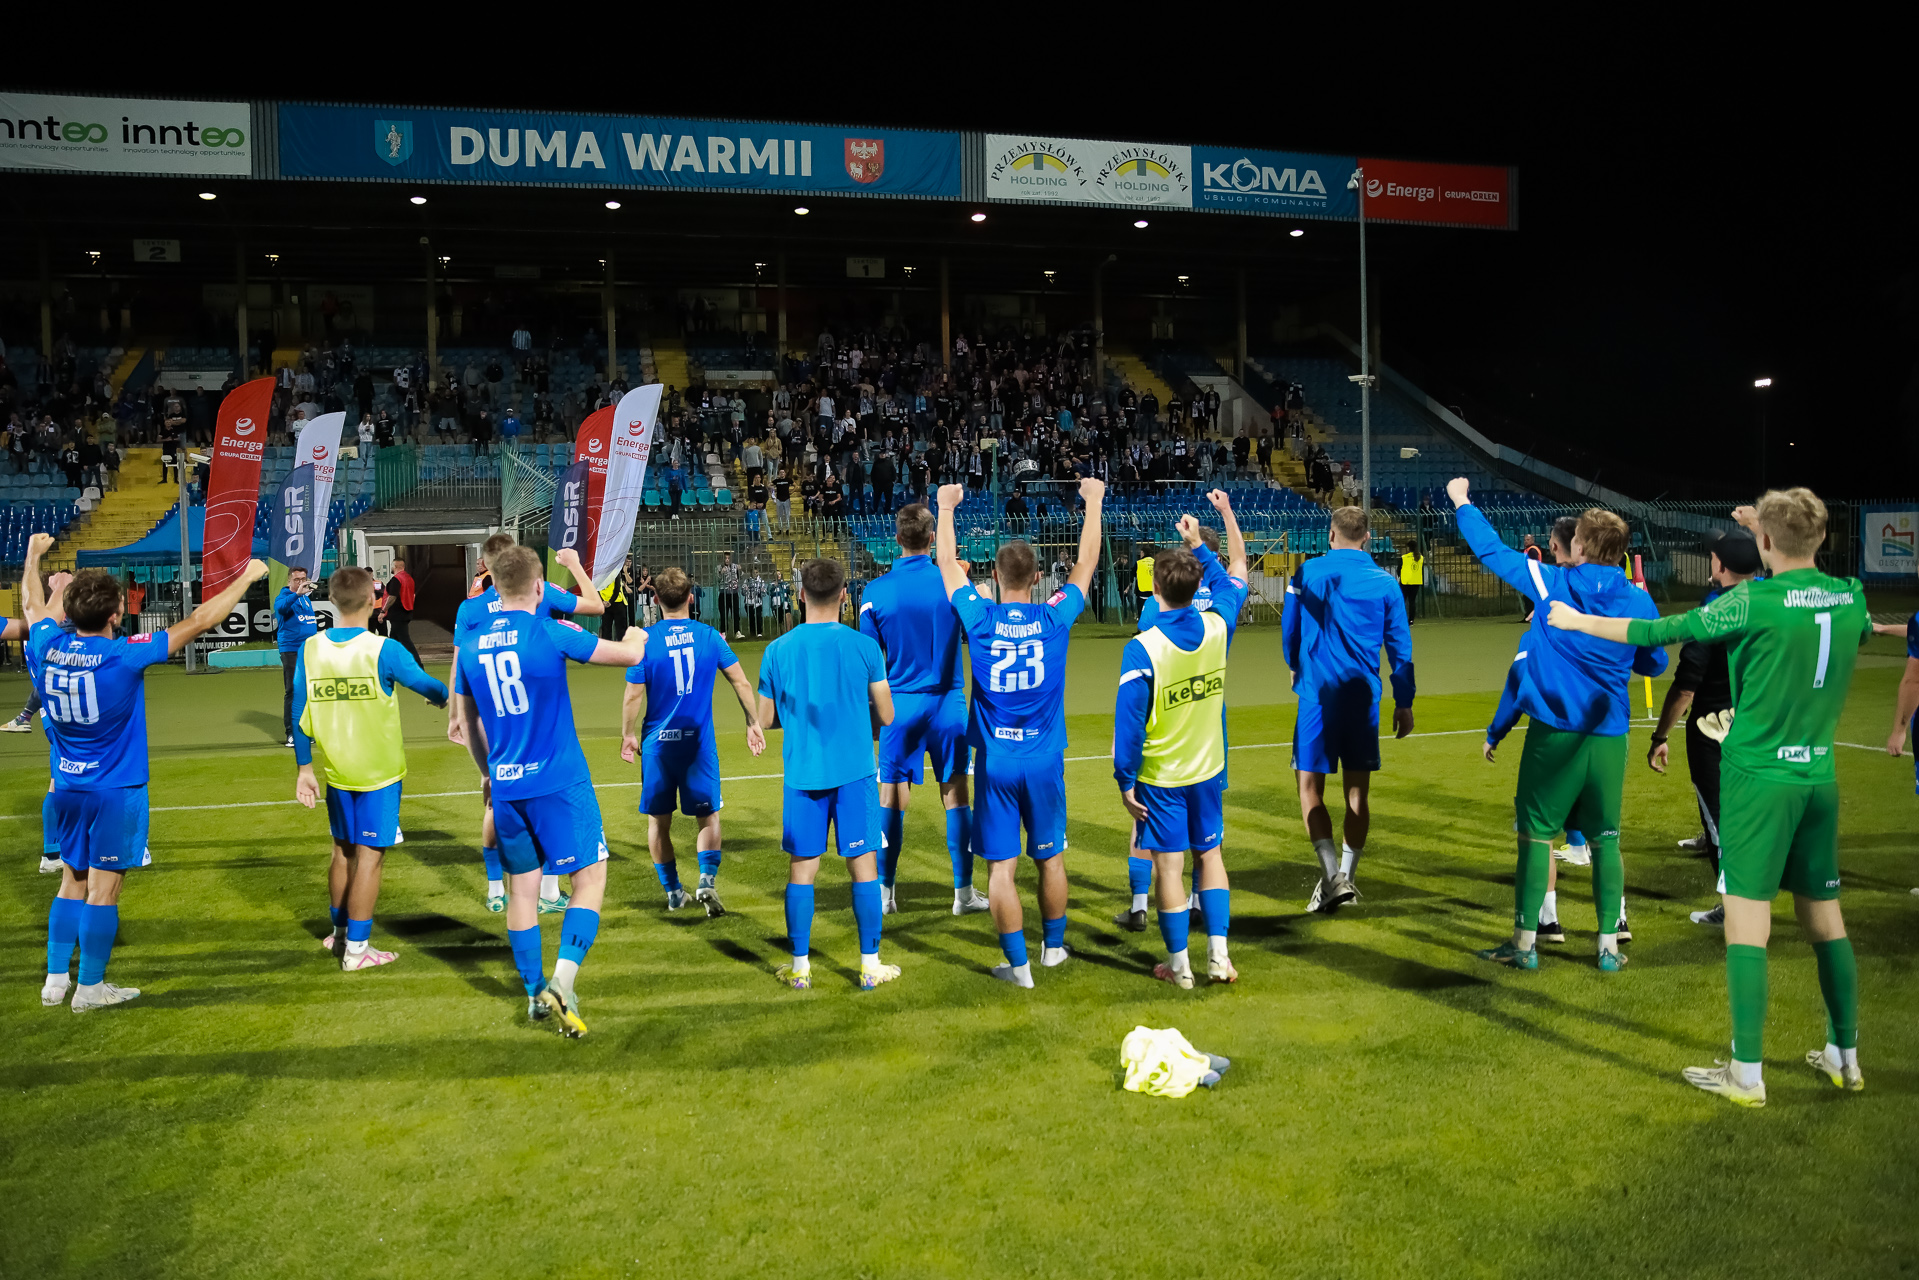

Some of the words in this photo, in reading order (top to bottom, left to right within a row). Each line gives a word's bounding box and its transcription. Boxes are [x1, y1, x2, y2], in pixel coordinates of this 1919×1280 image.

[450, 126, 606, 168] DUMA
[622, 132, 812, 177] WARMII
[991, 141, 1087, 187] PRZEMYSŁÓWKA
[1096, 147, 1189, 192] PRZEMYSŁÓWKA
[1010, 175, 1068, 187] HOLDING
[1203, 156, 1327, 194] KOMA
[1114, 181, 1170, 192] HOLDING
[1386, 182, 1435, 202] Energa
[1445, 190, 1471, 200] GRUPA
[1472, 191, 1499, 202] ORLEN
[1204, 194, 1248, 203] USŁUGI
[1254, 197, 1327, 208] KOMUNALNE
[149, 246, 167, 261] 2
[862, 264, 869, 277] 1
[221, 436, 263, 452] Energa
[616, 436, 650, 452] Energa
[219, 451, 240, 459] GRUPA
[241, 453, 261, 461] ORLEN
[301, 460, 335, 474] Eerga
[665, 631, 695, 647] WÓJCIK
[1814, 612, 1832, 689] 1
[668, 646, 696, 696] 11
[989, 639, 1045, 693] 23
[313, 681, 370, 698] keeza
[478, 650, 530, 718] 18
[1168, 676, 1223, 705] keeza
[45, 665, 100, 725] 50
[660, 731, 680, 740] DBK
[499, 765, 520, 778] DBK
